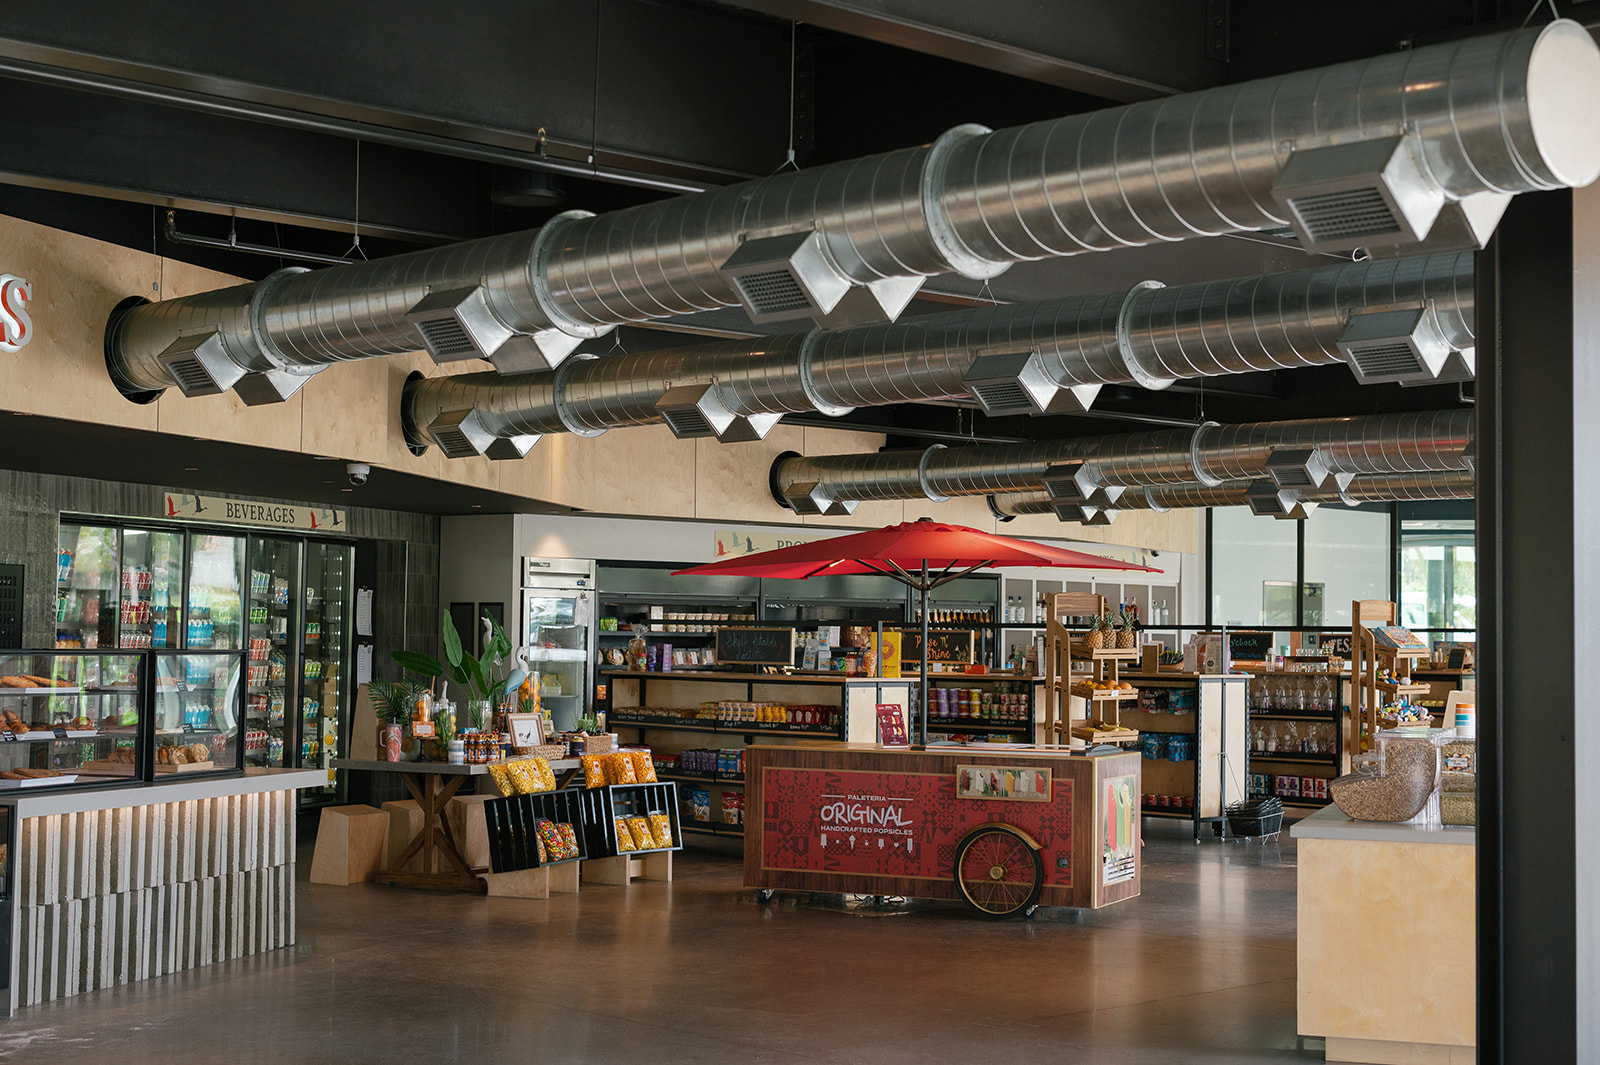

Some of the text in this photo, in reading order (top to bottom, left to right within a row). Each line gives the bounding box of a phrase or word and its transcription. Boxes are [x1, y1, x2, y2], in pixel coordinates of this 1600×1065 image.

[226, 502, 295, 524] BEVERAGES
[777, 540, 808, 550] PR
[847, 794, 887, 802] PALETERIA
[820, 802, 913, 827] ORIGINAL
[820, 825, 914, 836] HANDCRAFTED POPSICLES
